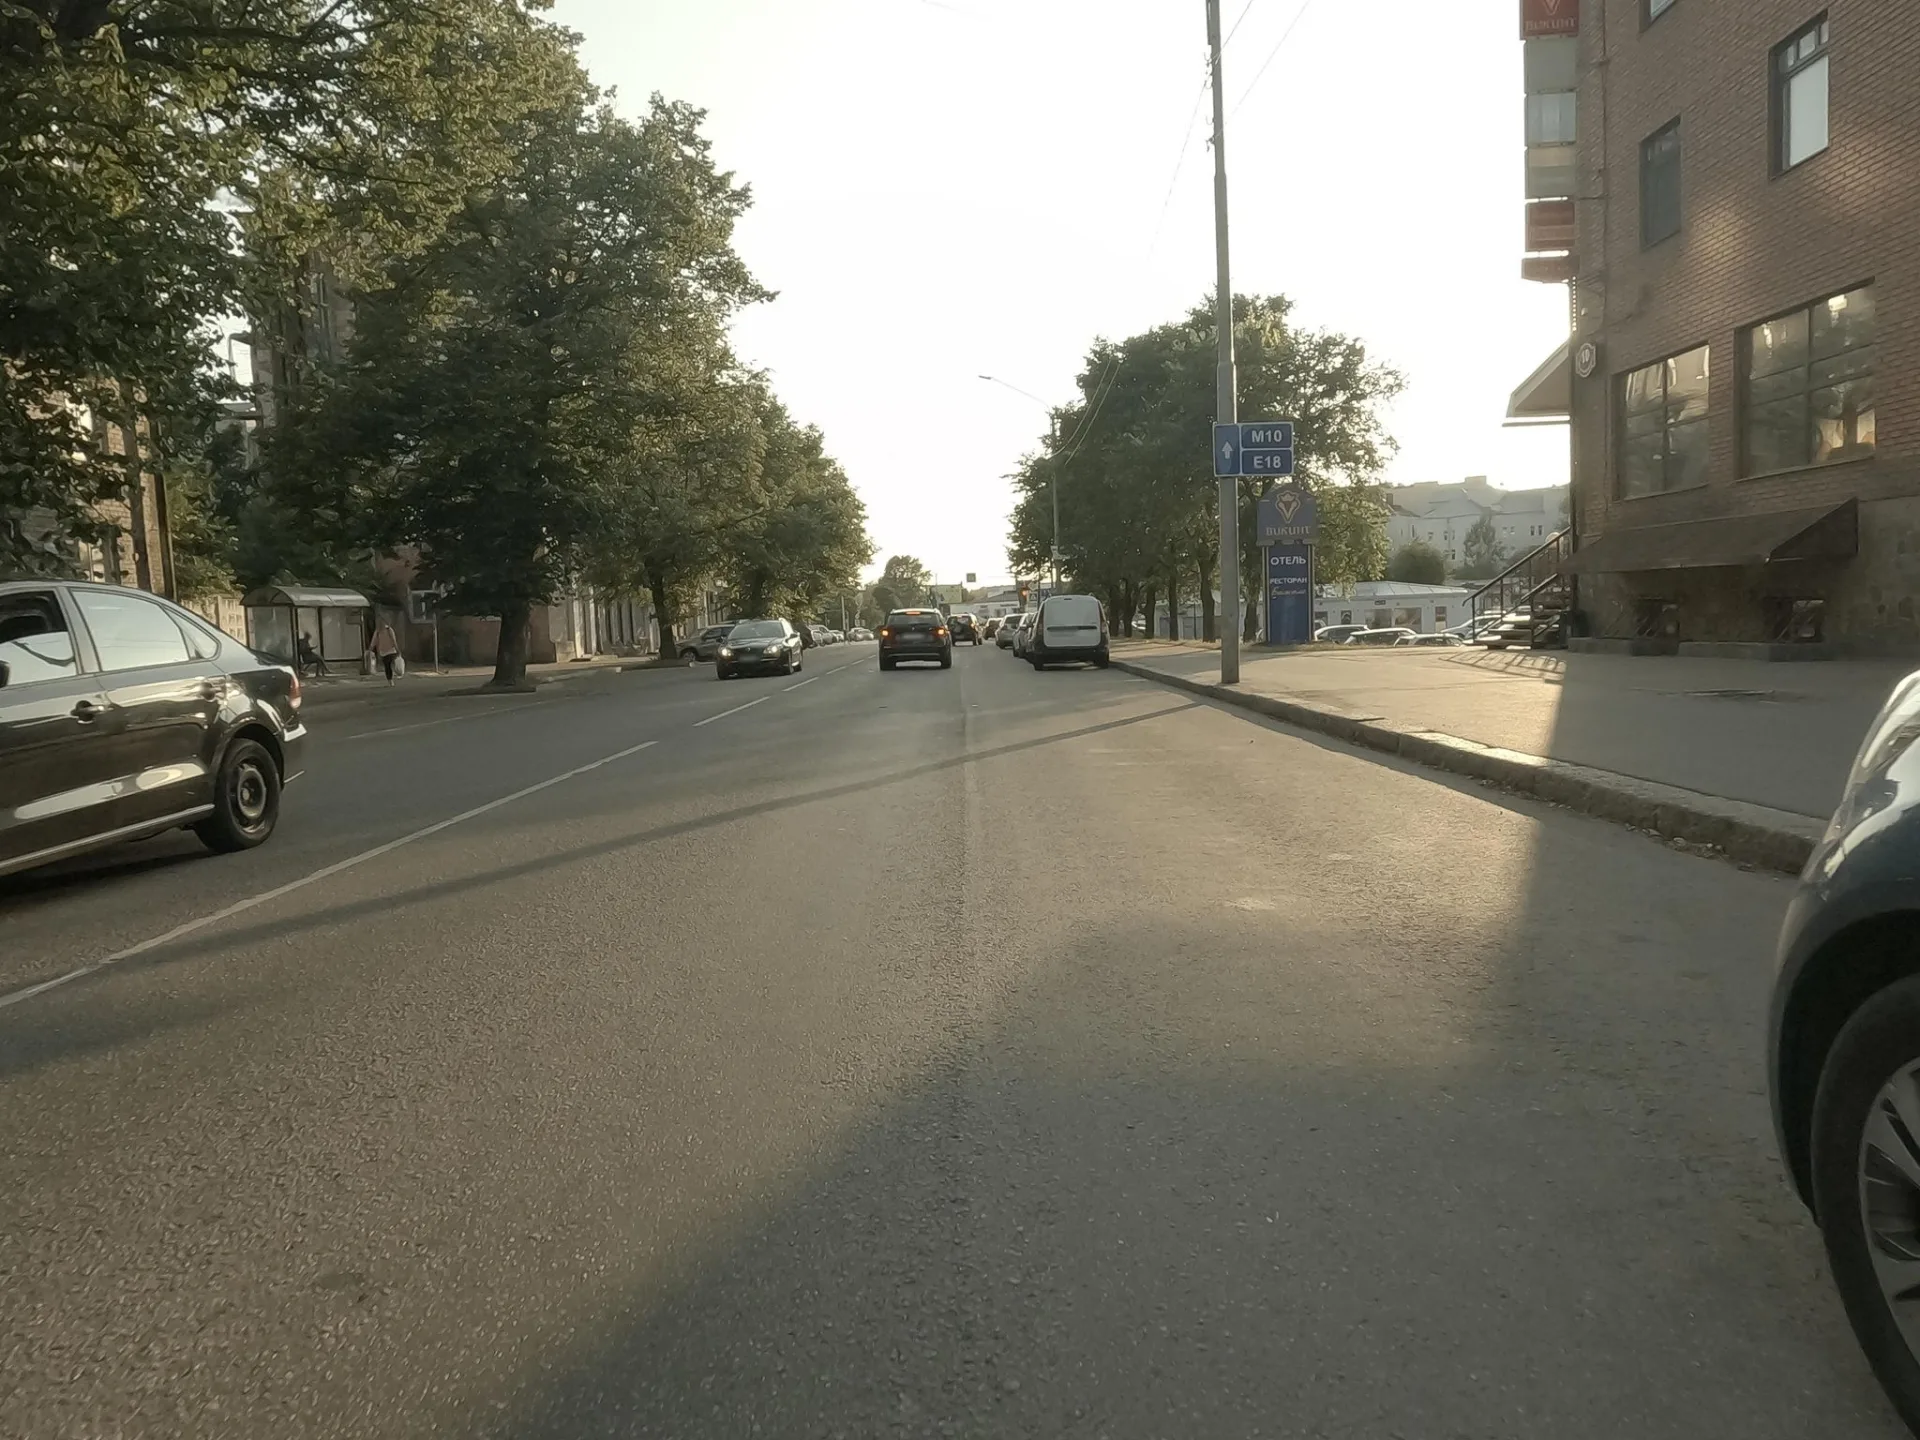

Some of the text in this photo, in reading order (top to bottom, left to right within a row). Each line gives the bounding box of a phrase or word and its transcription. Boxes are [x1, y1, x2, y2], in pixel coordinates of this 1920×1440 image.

[1251, 430, 1282, 443] M10
[1253, 455, 1282, 469] E18
[1270, 556, 1307, 566] ОТЕЛЬ
[1270, 577, 1308, 585] РЕСТОРАН
